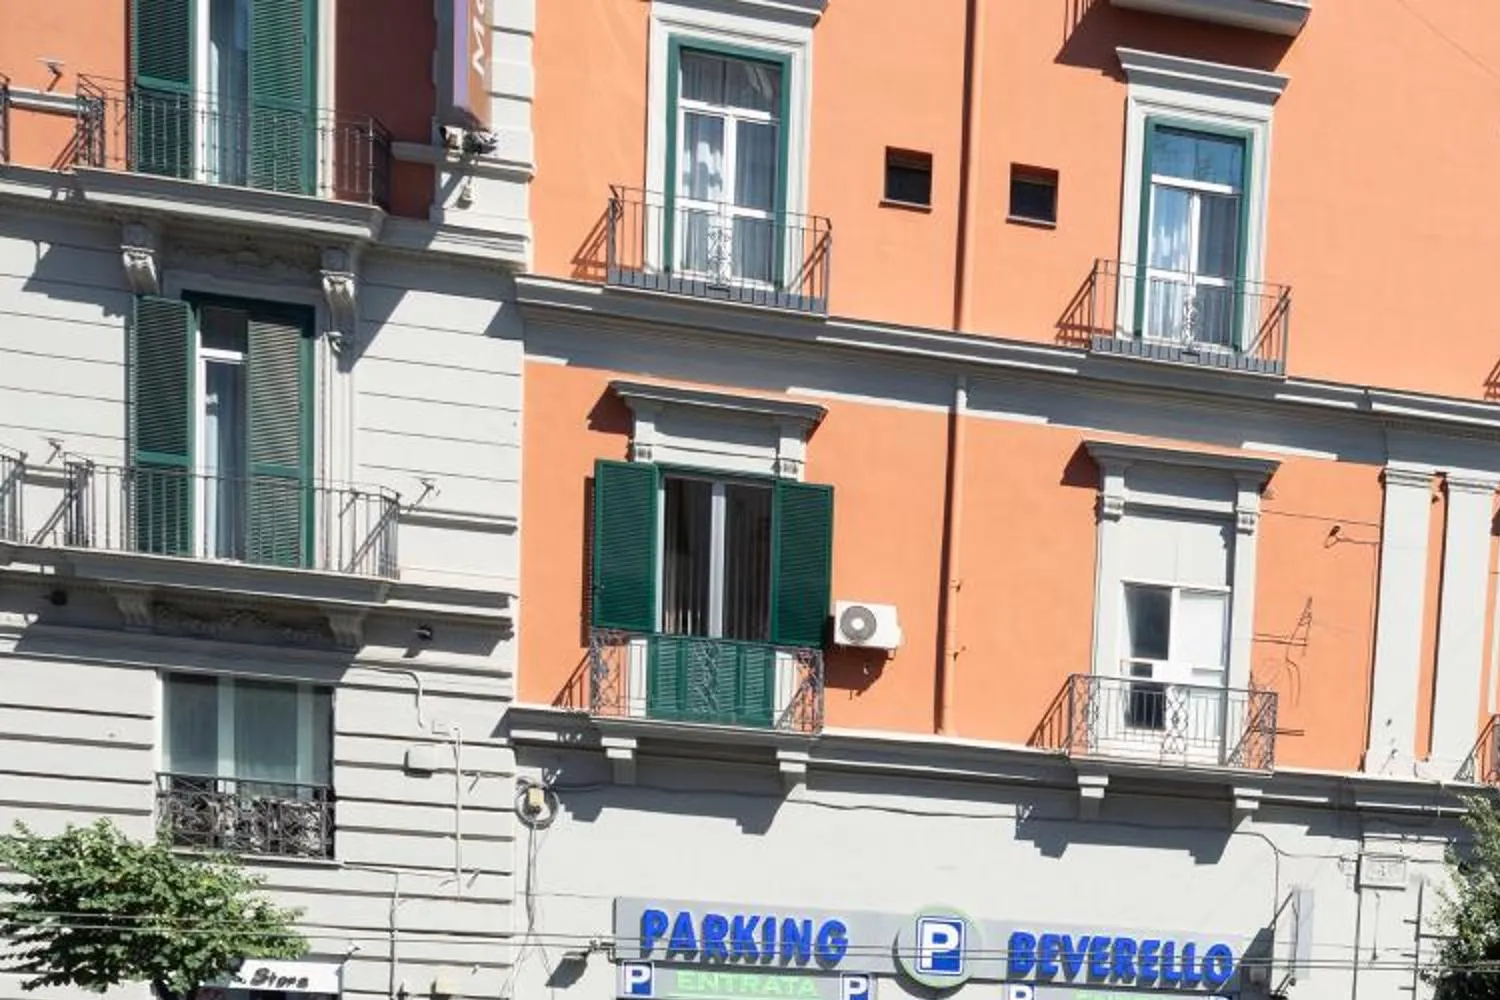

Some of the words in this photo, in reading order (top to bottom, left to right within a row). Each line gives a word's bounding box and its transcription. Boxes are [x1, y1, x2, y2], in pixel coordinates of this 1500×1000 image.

[640, 909, 849, 967] PARKING
[1007, 931, 1234, 986] BEVERELLO
[921, 922, 960, 969] P
[624, 965, 650, 995] P
[677, 970, 818, 997] ENTRATA
